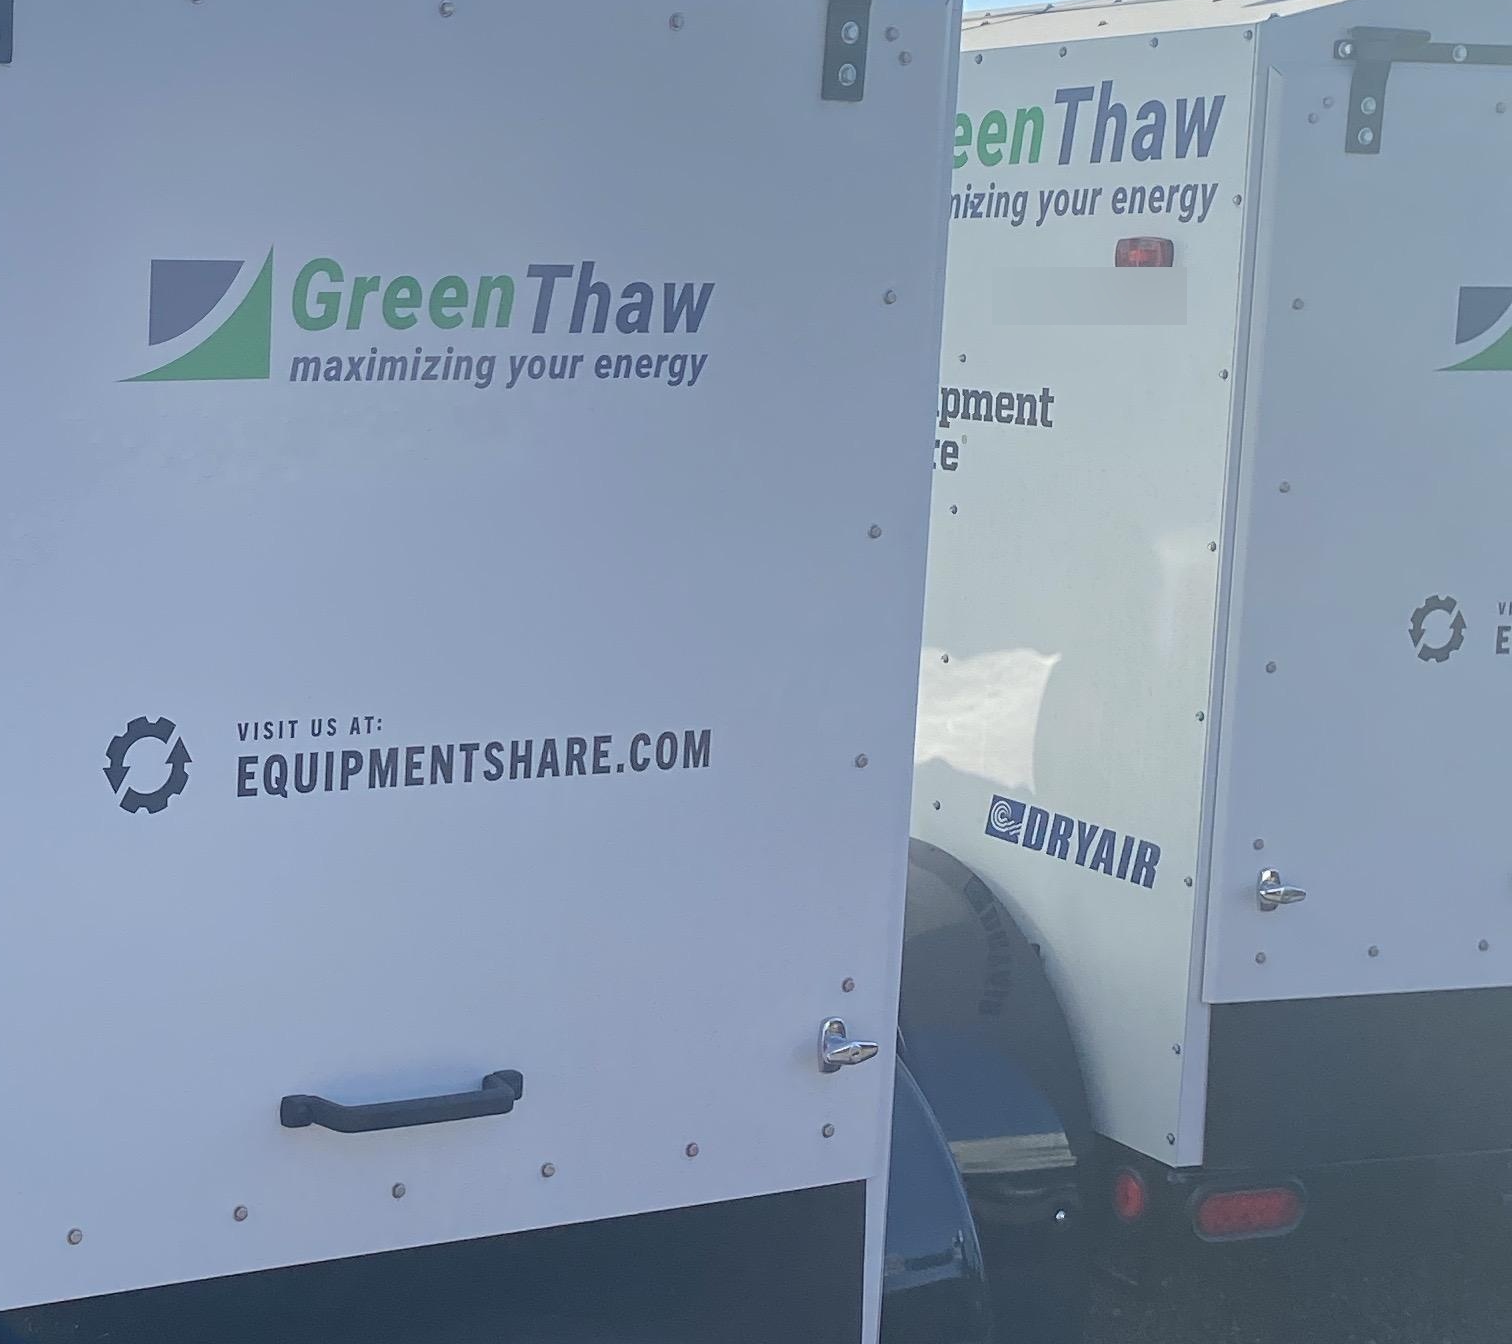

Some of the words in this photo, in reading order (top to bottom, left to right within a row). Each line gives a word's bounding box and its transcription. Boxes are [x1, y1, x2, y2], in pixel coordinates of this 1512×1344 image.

[954, 80, 1226, 168] eenThaw
[1035, 187, 1102, 227] your
[1111, 182, 1219, 224] energy
[292, 257, 716, 334] GreenThaw
[289, 346, 496, 390] maximizing
[506, 355, 583, 389] your
[594, 351, 709, 388] energy
[937, 387, 1055, 429] pment
[237, 720, 299, 742] VISIT
[311, 718, 337, 738] US
[349, 715, 383, 736] AT:
[237, 729, 712, 799] EQUIPMENTSHARE.COM
[1021, 805, 1161, 890] DRYAIR
